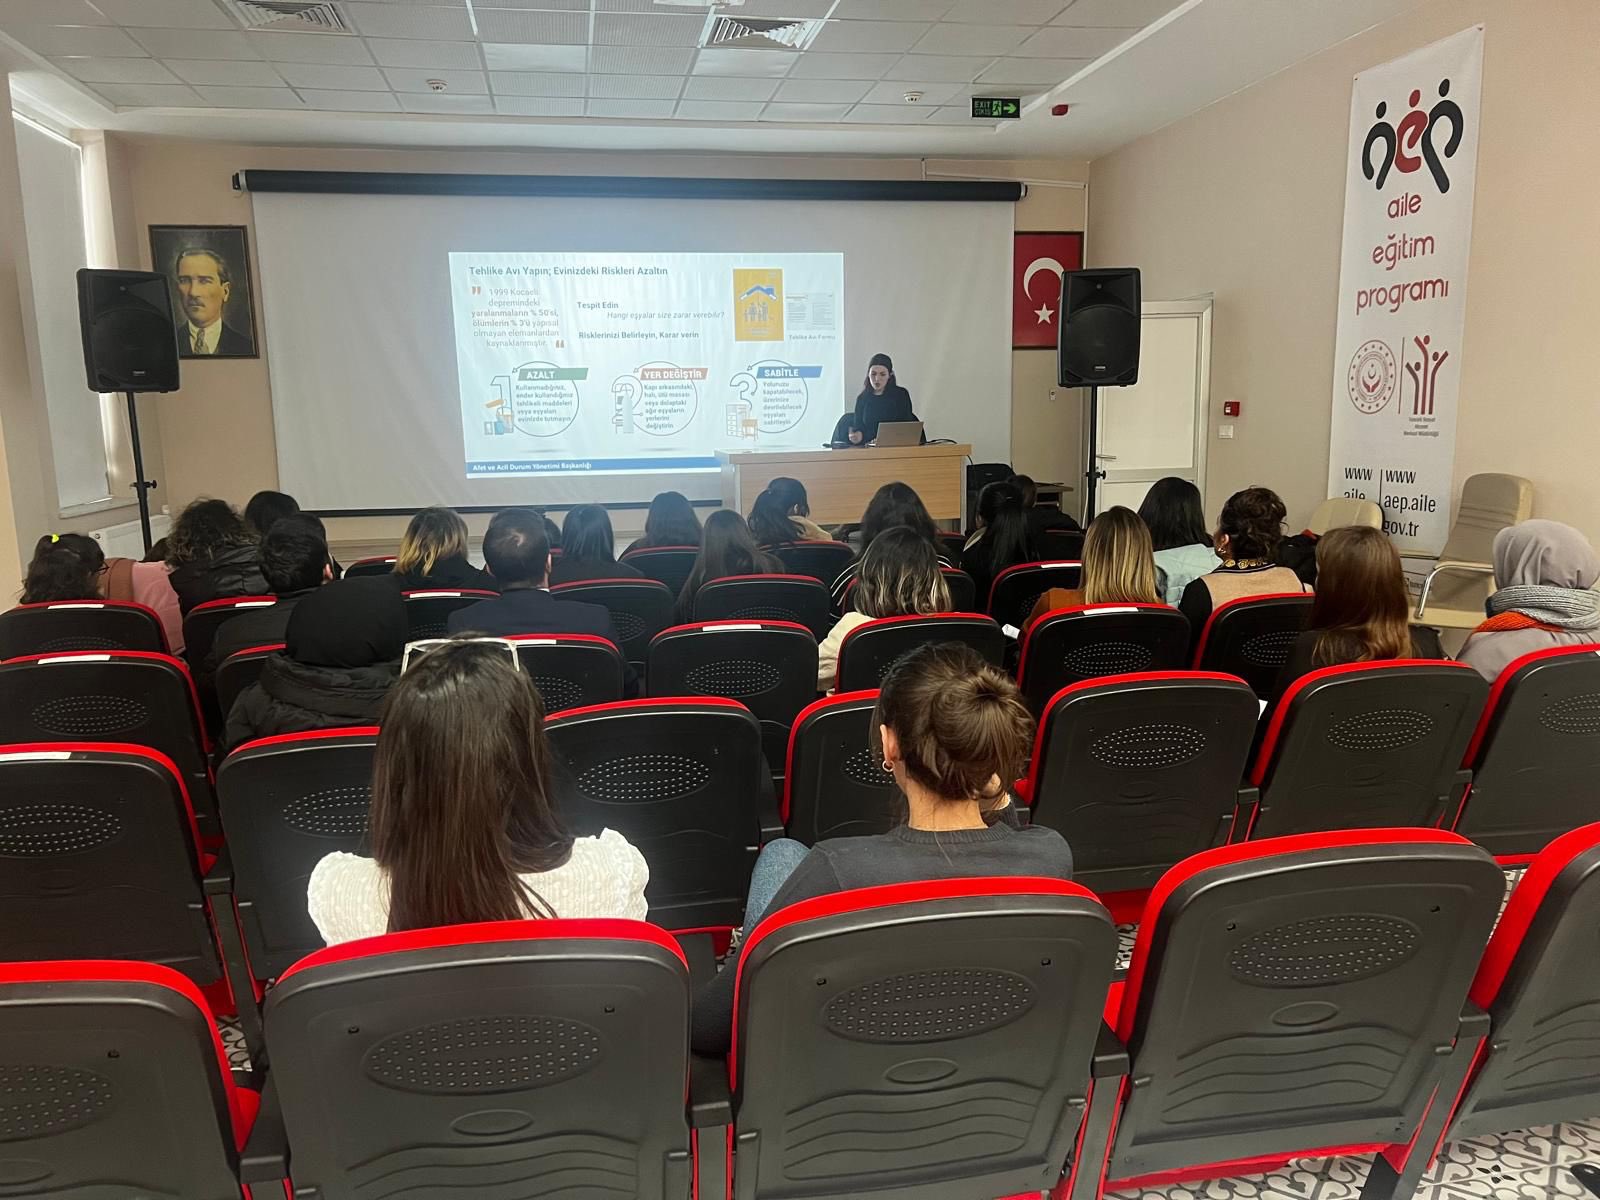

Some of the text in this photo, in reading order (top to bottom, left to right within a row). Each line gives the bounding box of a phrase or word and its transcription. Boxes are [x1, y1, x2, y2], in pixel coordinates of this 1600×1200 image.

[975, 101, 991, 109] EXIT
[1387, 192, 1422, 218] aile
[1372, 233, 1435, 271] eğitim
[469, 265, 668, 278] Tehlike Avı Yapın; Evinizdeki Riskleri Azaltın
[510, 288, 540, 296] Kocaeli
[1356, 278, 1448, 316] programı
[488, 299, 540, 308] depremindeki
[577, 302, 600, 310] Tespit
[472, 309, 528, 318] yaralanmaların
[608, 312, 628, 320] Hangi
[630, 312, 655, 320] eşyalar
[472, 318, 509, 327] ölümlerin
[532, 319, 559, 328] yapısal
[474, 329, 560, 339] olmayan elemanlardan
[578, 332, 620, 340] Risklerinizi
[622, 332, 658, 340] Belirleyin,
[681, 331, 699, 339] verin
[526, 371, 555, 380] AZALT
[644, 368, 702, 380] YER DEĞİŞTİR
[764, 368, 799, 377] SABİTLE
[561, 462, 592, 470] Başkanlığı
[1344, 468, 1372, 480] www
[1386, 470, 1416, 484] www
[1384, 494, 1436, 514] aep.aile
